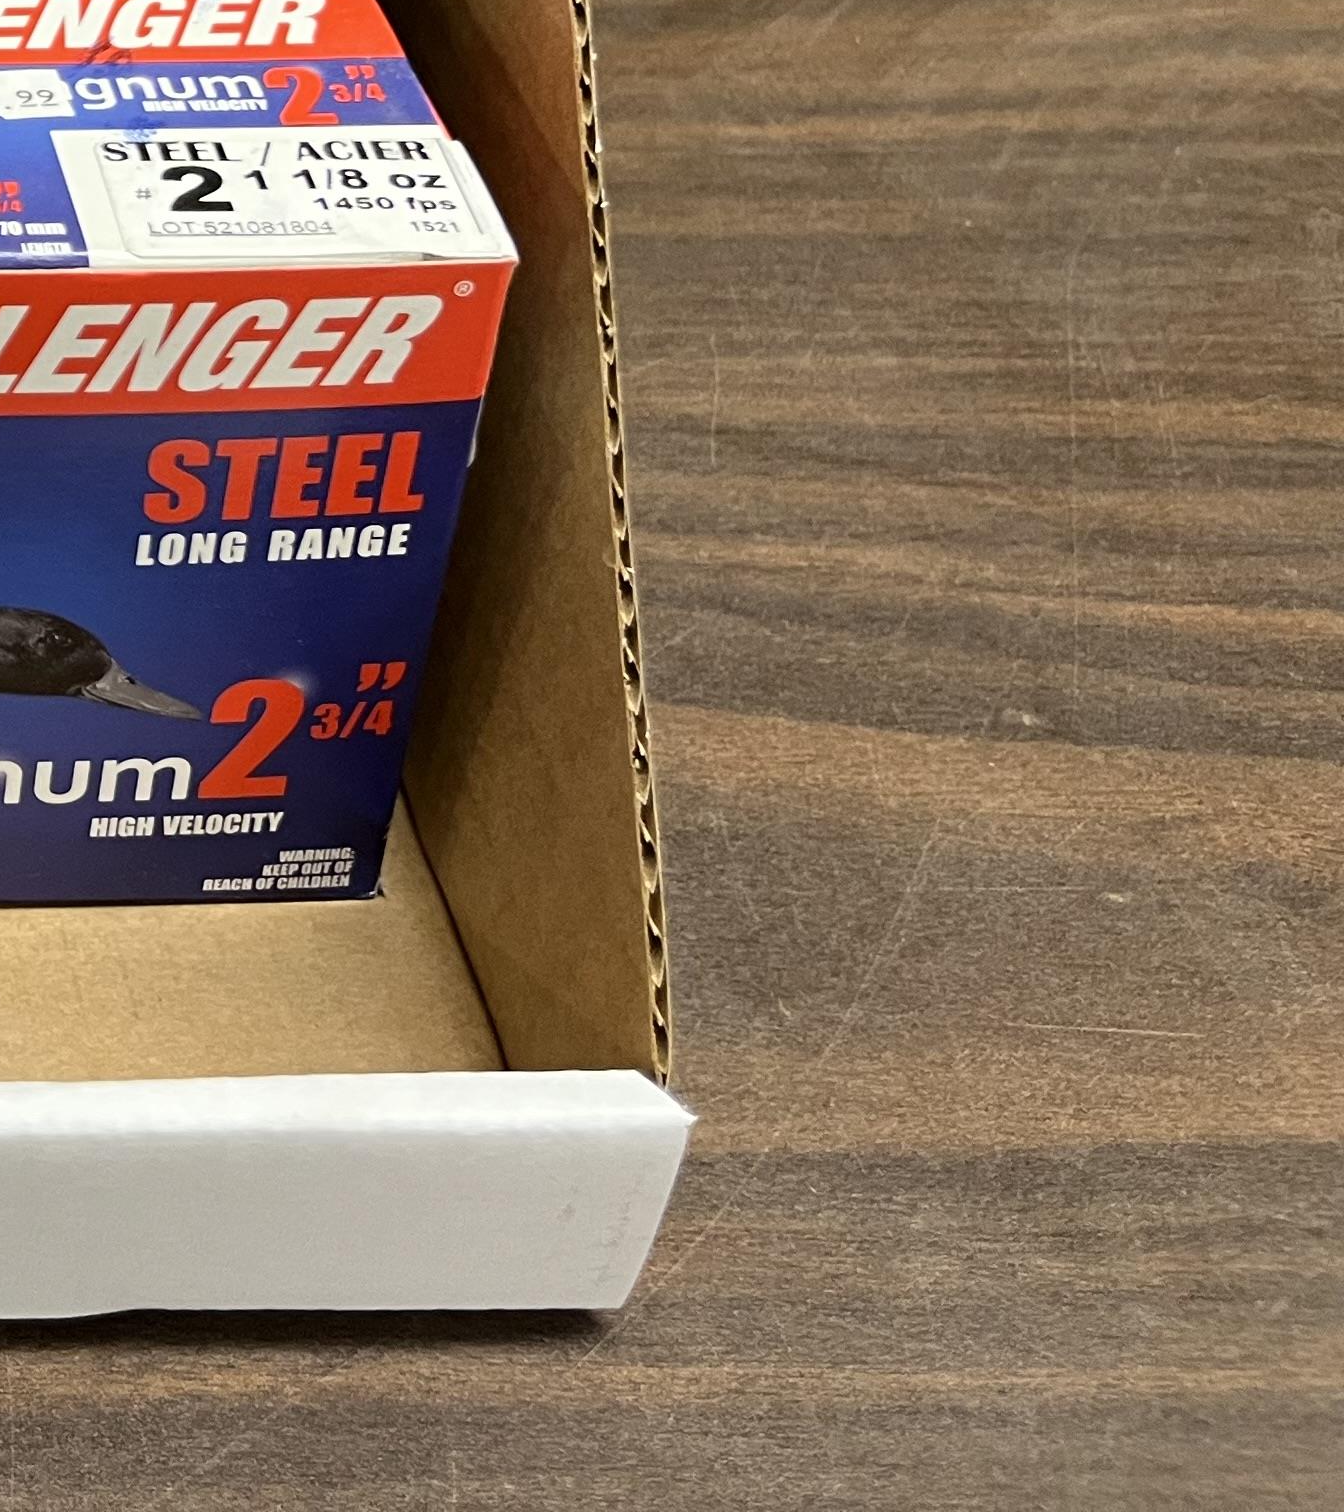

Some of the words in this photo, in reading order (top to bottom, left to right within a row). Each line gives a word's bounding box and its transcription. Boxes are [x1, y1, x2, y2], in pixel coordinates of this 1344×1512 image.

[74, 71, 265, 111] gnum
[262, 65, 340, 126] 2
[328, 82, 386, 103] 3/4
[100, 141, 243, 163] STEEL
[296, 140, 431, 161] ACIER
[159, 164, 235, 213] 2
[292, 168, 370, 190] 1/8
[388, 173, 448, 190] oz
[312, 196, 395, 211] 1450
[406, 196, 458, 214] fps
[142, 431, 425, 524] STEEL
[134, 530, 248, 567] LONG
[267, 523, 411, 563] RANGE
[197, 677, 306, 800] 2
[310, 699, 394, 740] 3/4
[89, 816, 155, 838] HIGH
[162, 811, 285, 836] VELOCITY
[261, 863, 299, 877] KEEP
[301, 862, 332, 876] OUT
[334, 860, 354, 874] OF
[278, 847, 356, 863] WARNING:
[202, 877, 252, 892] REACH
[255, 876, 276, 891] OF
[276, 874, 351, 890] CHILDREN
